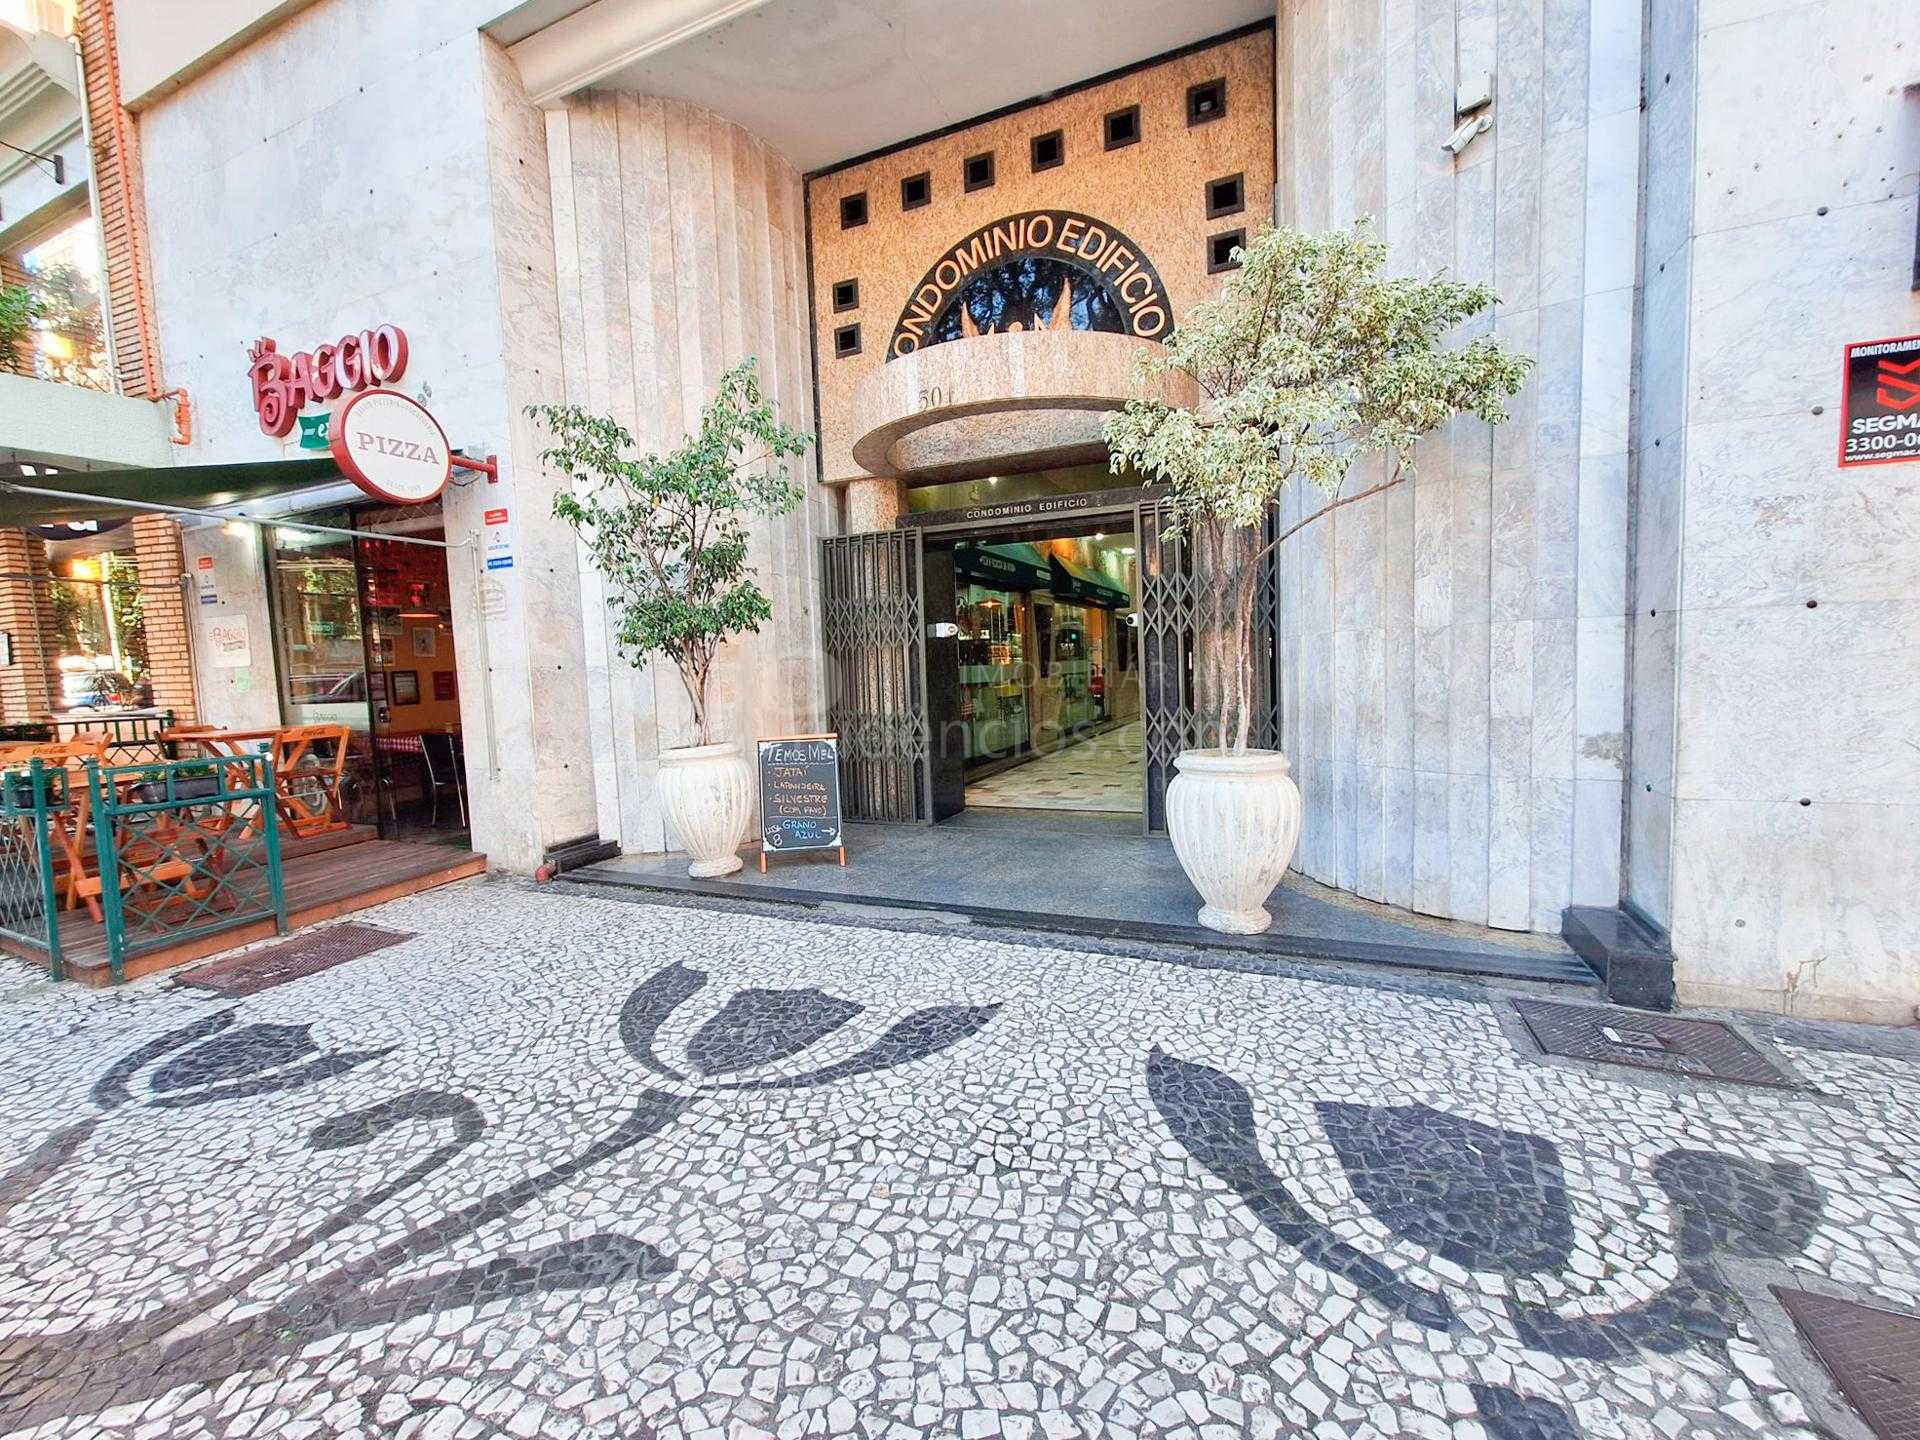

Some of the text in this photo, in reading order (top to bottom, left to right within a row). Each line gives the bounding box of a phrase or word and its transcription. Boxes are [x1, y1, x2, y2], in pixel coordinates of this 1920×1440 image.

[893, 214, 1166, 357] ONDOMINIO EDIFICIO
[248, 323, 409, 437] BAGGIO
[918, 386, 952, 410] 501
[356, 432, 441, 465] PIZZA
[966, 498, 1088, 519] CONDOMINIO EDIFICIO
[767, 744, 807, 762] TEMOS
[773, 794, 828, 804] SILVESTRE
[782, 819, 817, 830] GRANO
[772, 833, 783, 847] 8
[794, 830, 822, 840] AZUL
